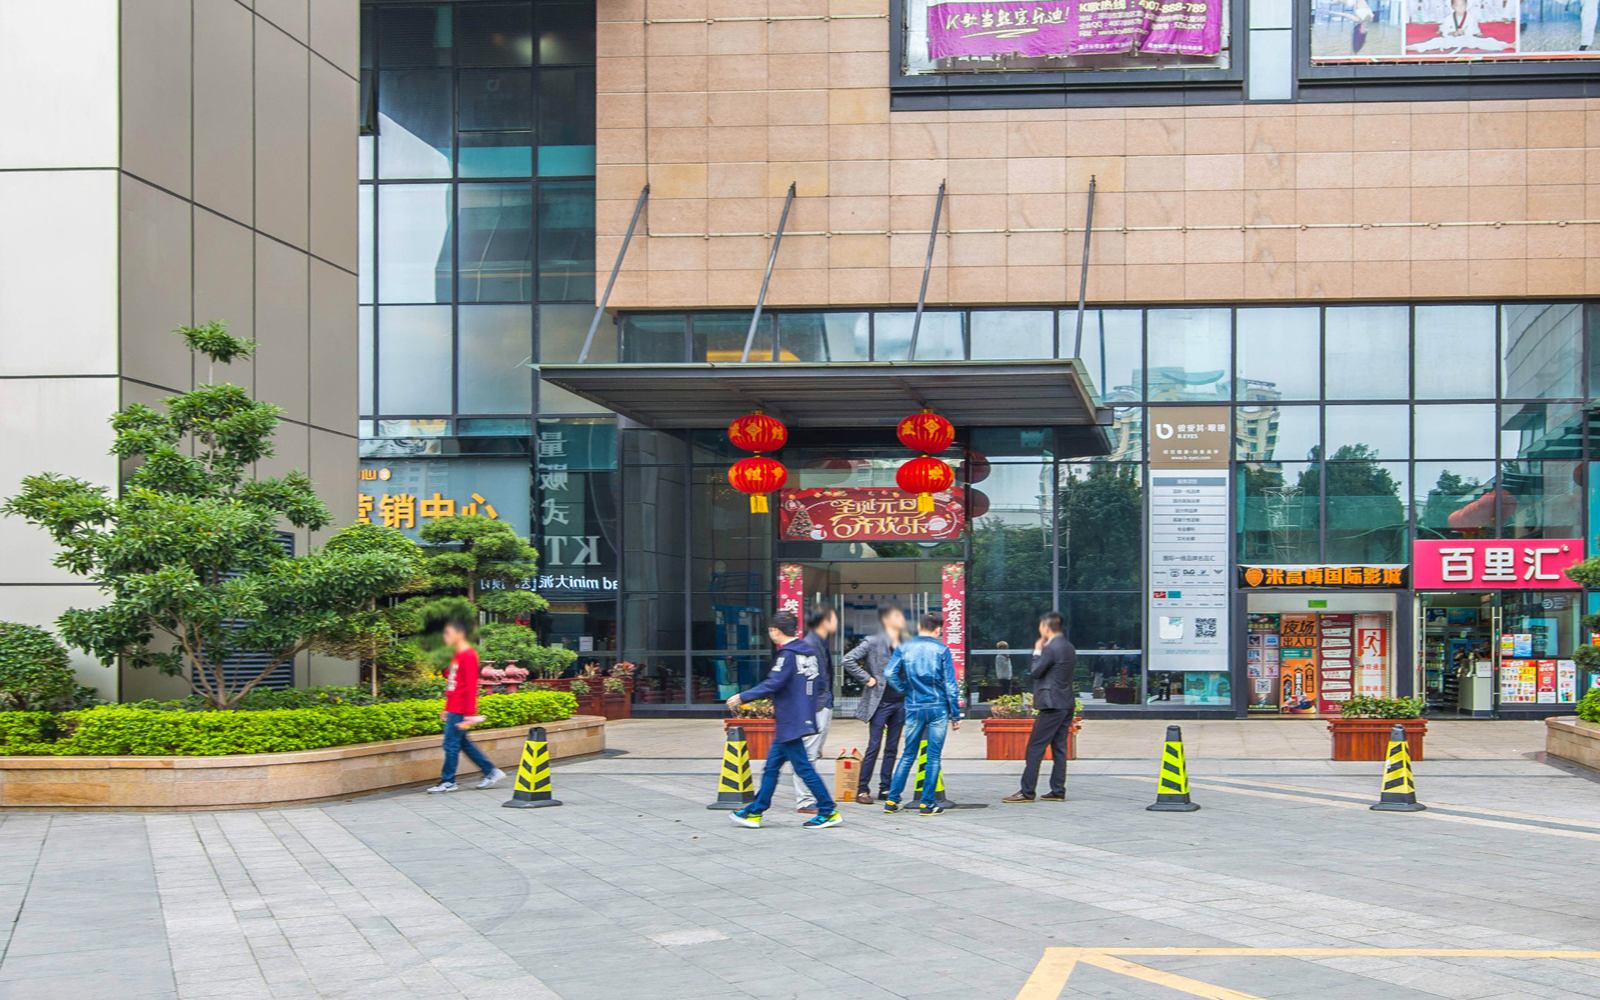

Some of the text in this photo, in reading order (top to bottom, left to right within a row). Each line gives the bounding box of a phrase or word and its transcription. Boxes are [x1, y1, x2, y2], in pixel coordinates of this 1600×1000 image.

[829, 514, 928, 539] 齐欢乐
[1439, 547, 1560, 581] 百里汇
[1265, 567, 1402, 585] 米高梅国际影城
[1283, 620, 1316, 635] 夜场
[1283, 637, 1314, 648] 出入口
